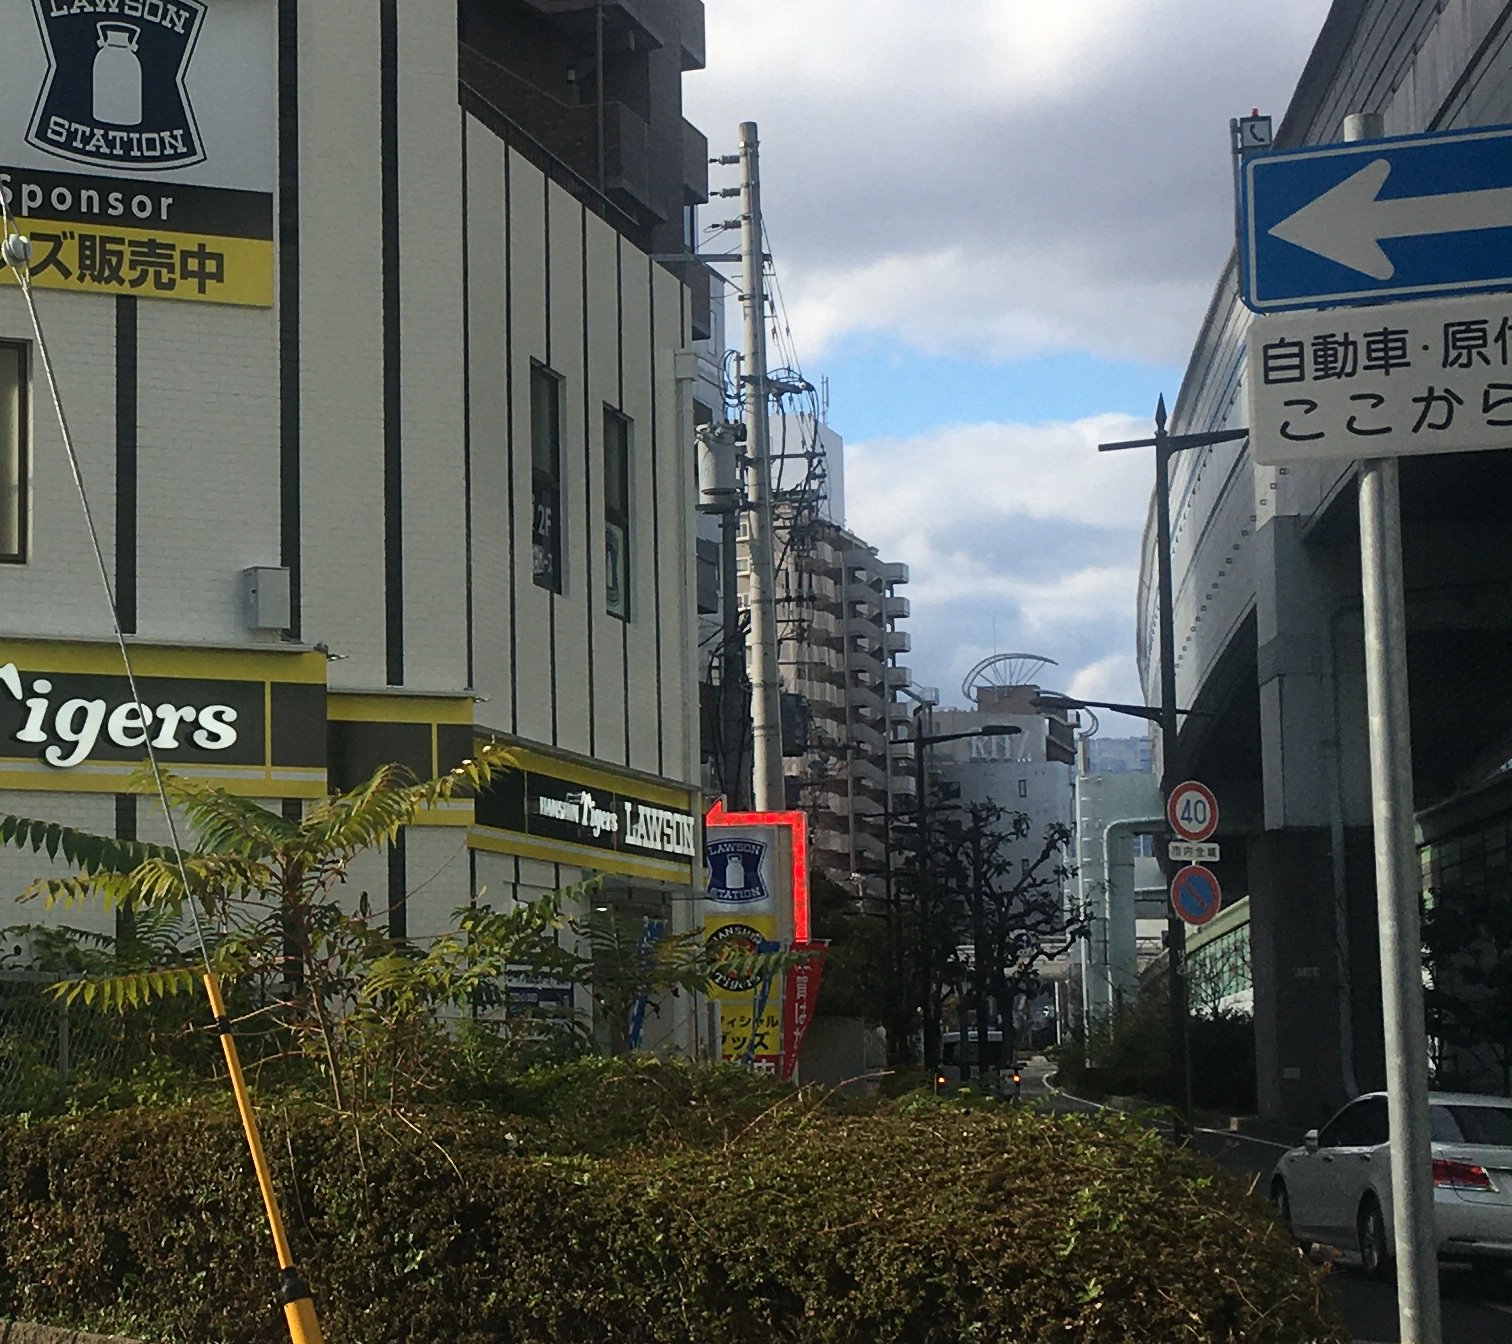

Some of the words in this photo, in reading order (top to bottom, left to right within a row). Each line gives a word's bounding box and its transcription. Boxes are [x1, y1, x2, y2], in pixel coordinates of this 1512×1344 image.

[47, 116, 187, 157] STATION
[1279, 383, 1512, 442] ここから
[539, 796, 579, 823] HANSHIN
[581, 791, 618, 838] Tigers
[624, 802, 695, 856] LAWSON
[1180, 799, 1207, 825] 40
[709, 844, 760, 855] LAWSON
